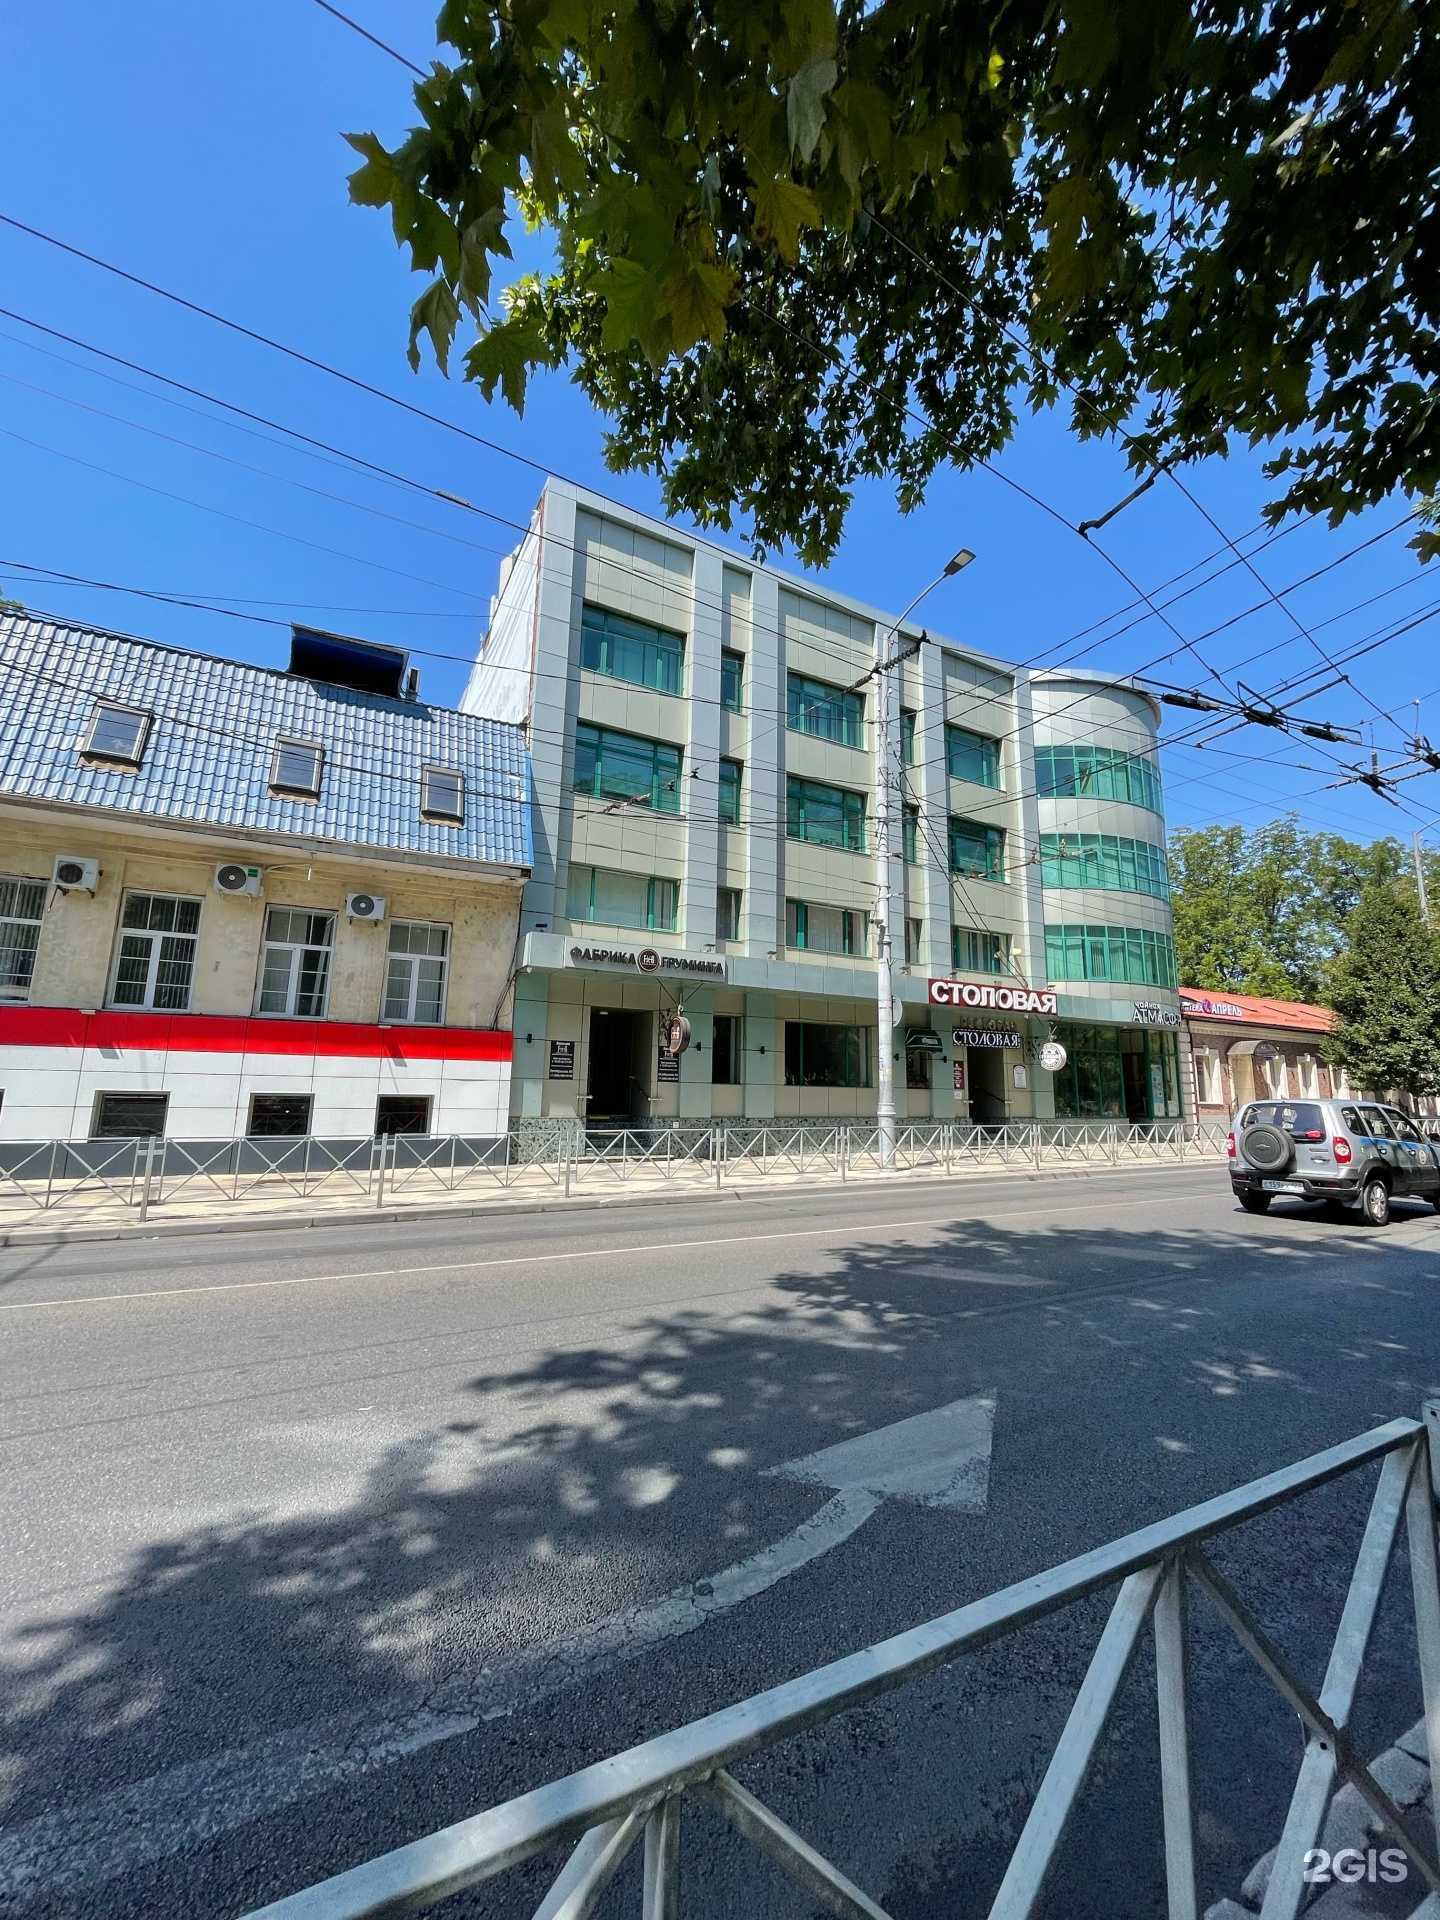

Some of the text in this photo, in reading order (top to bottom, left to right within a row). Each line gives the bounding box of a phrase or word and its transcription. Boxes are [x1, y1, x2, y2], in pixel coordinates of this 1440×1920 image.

[570, 946, 636, 964] ФАБРИКА
[661, 956, 723, 974] ГРУМИНГА
[931, 981, 1057, 1014] СТОЛОВАЯ
[1212, 1002, 1242, 1017] АПРЕЛЬ
[952, 1030, 1019, 1047] СТОЛОВАЯ
